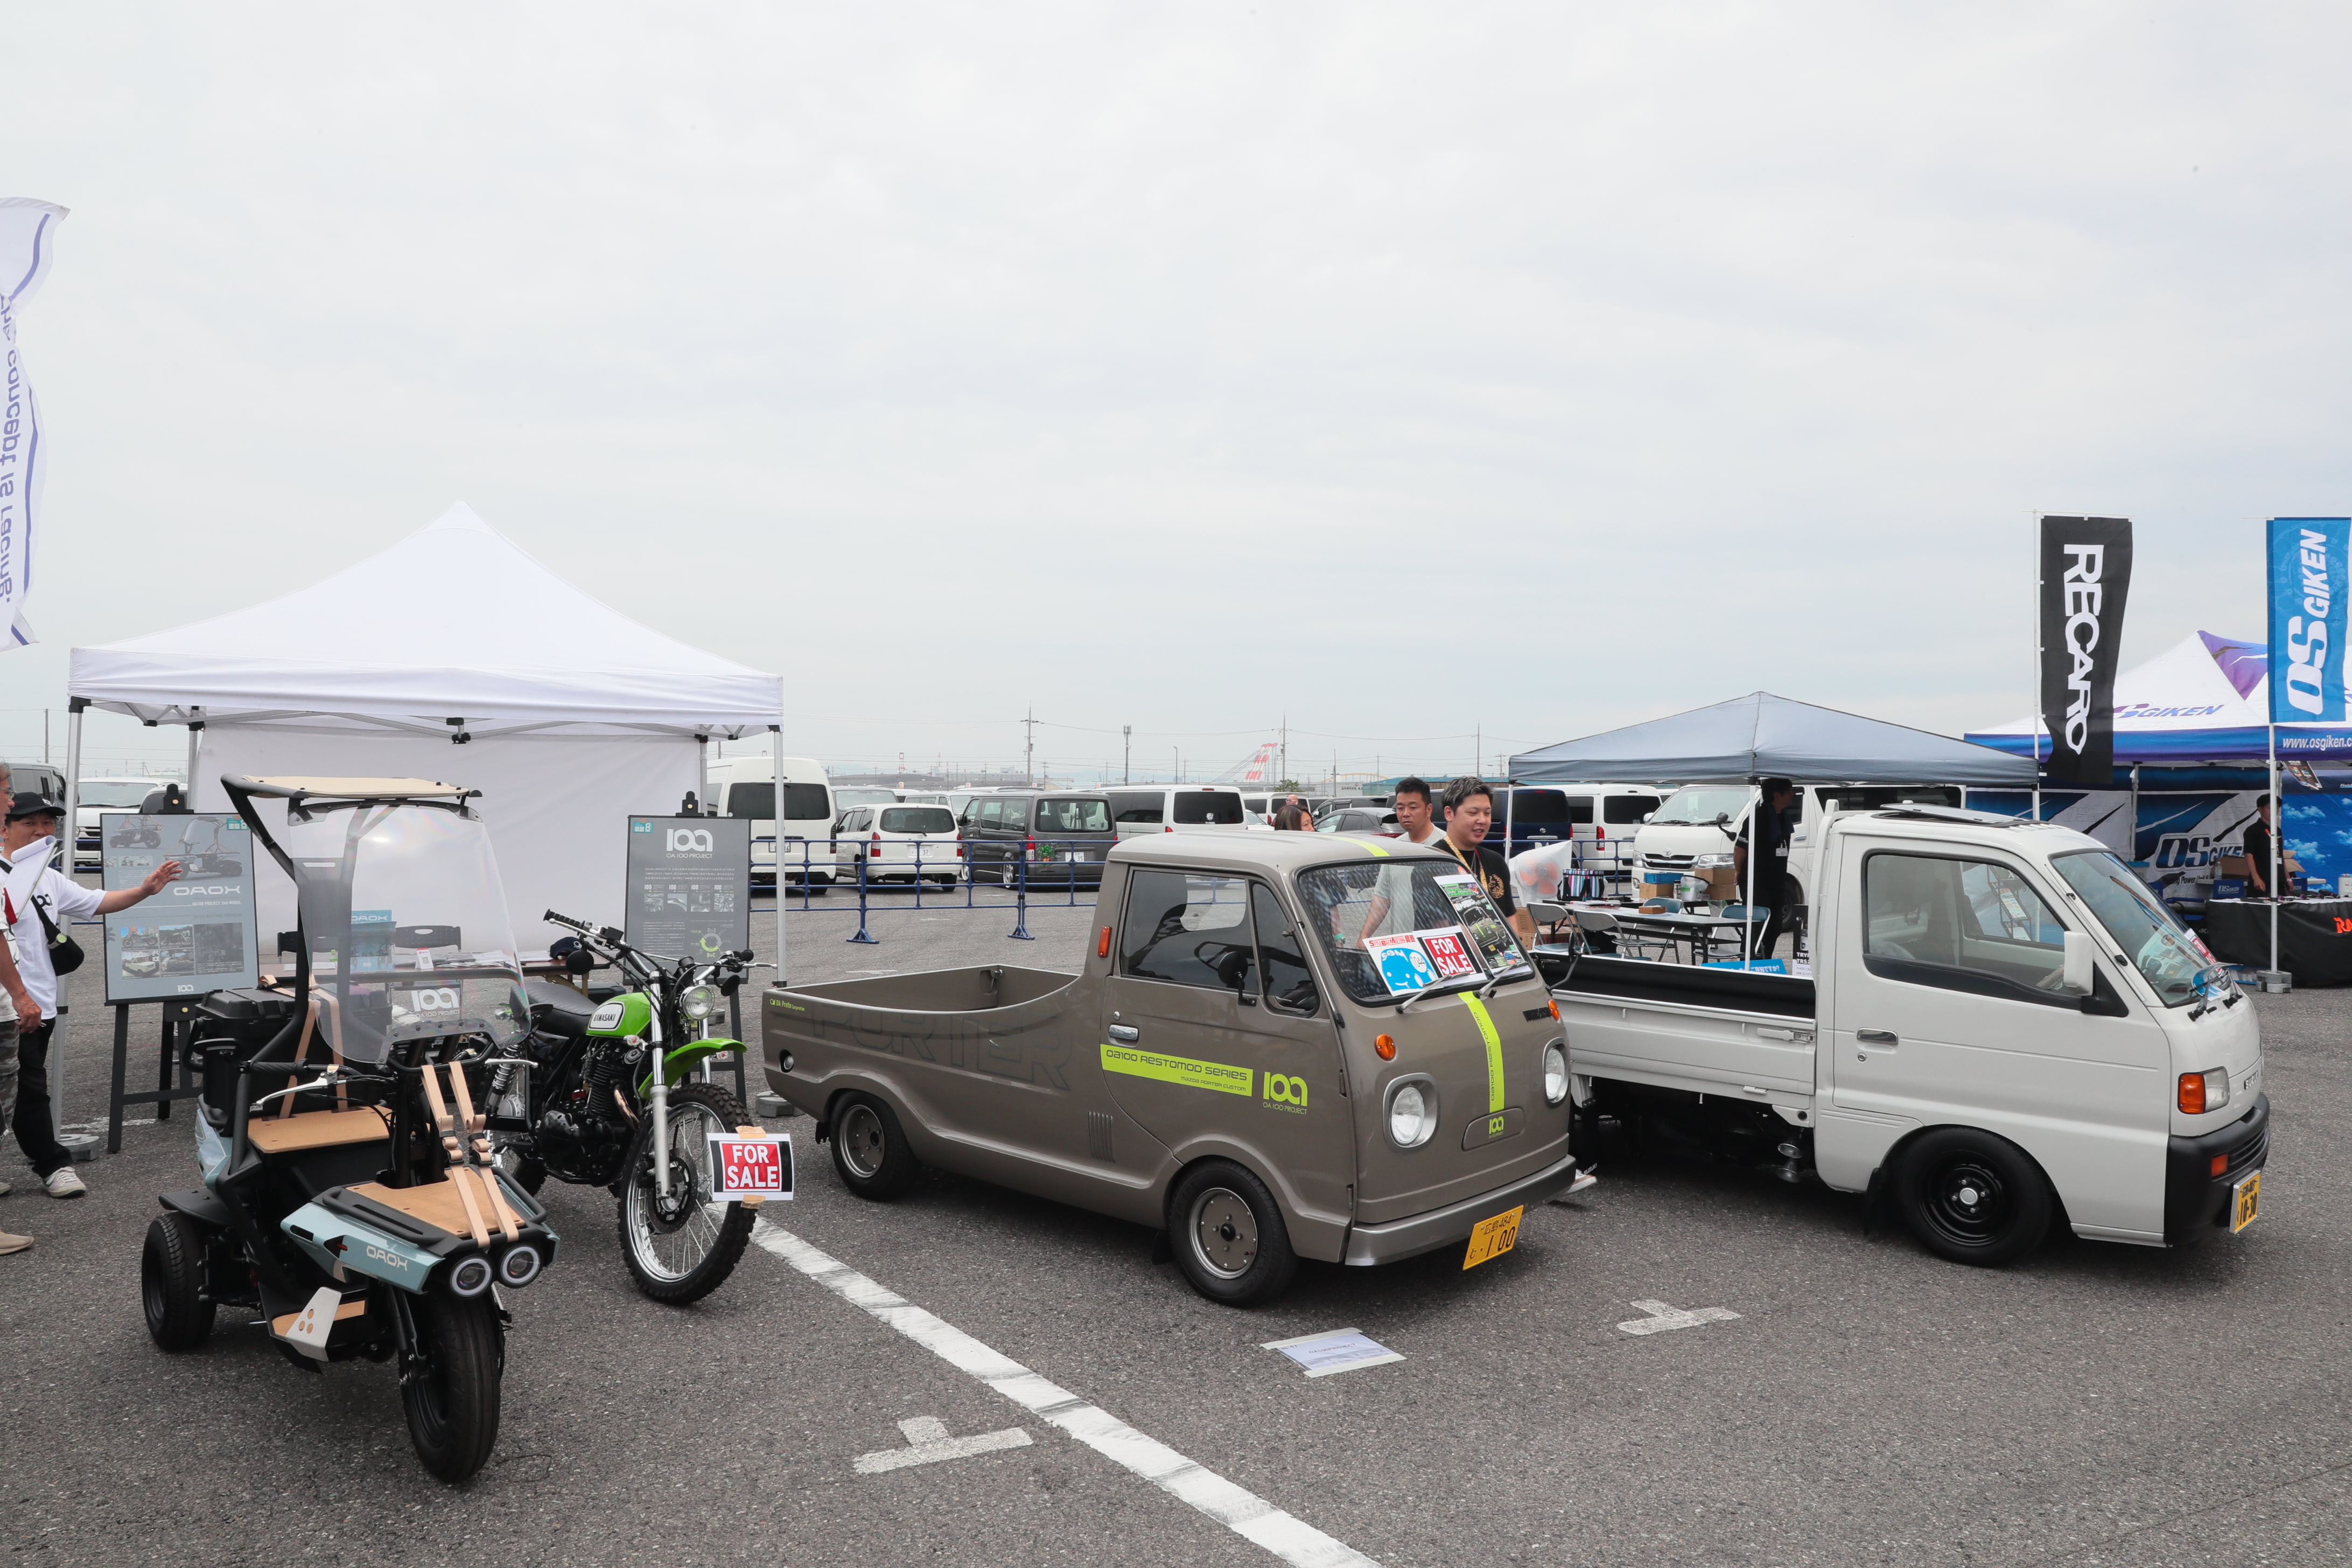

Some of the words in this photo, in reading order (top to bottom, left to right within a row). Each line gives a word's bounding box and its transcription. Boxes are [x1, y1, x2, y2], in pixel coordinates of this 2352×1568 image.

[2063, 544, 2104, 755] RECARO
[1430, 937, 1458, 955] FOR
[1436, 954, 1473, 975] SALE
[782, 1000, 792, 1009] Proto
[593, 1013, 616, 1021] KAWASAKI
[1284, 1105, 1307, 1115] PROJECT
[732, 1145, 769, 1164] FOR
[727, 1165, 779, 1188] SALE
